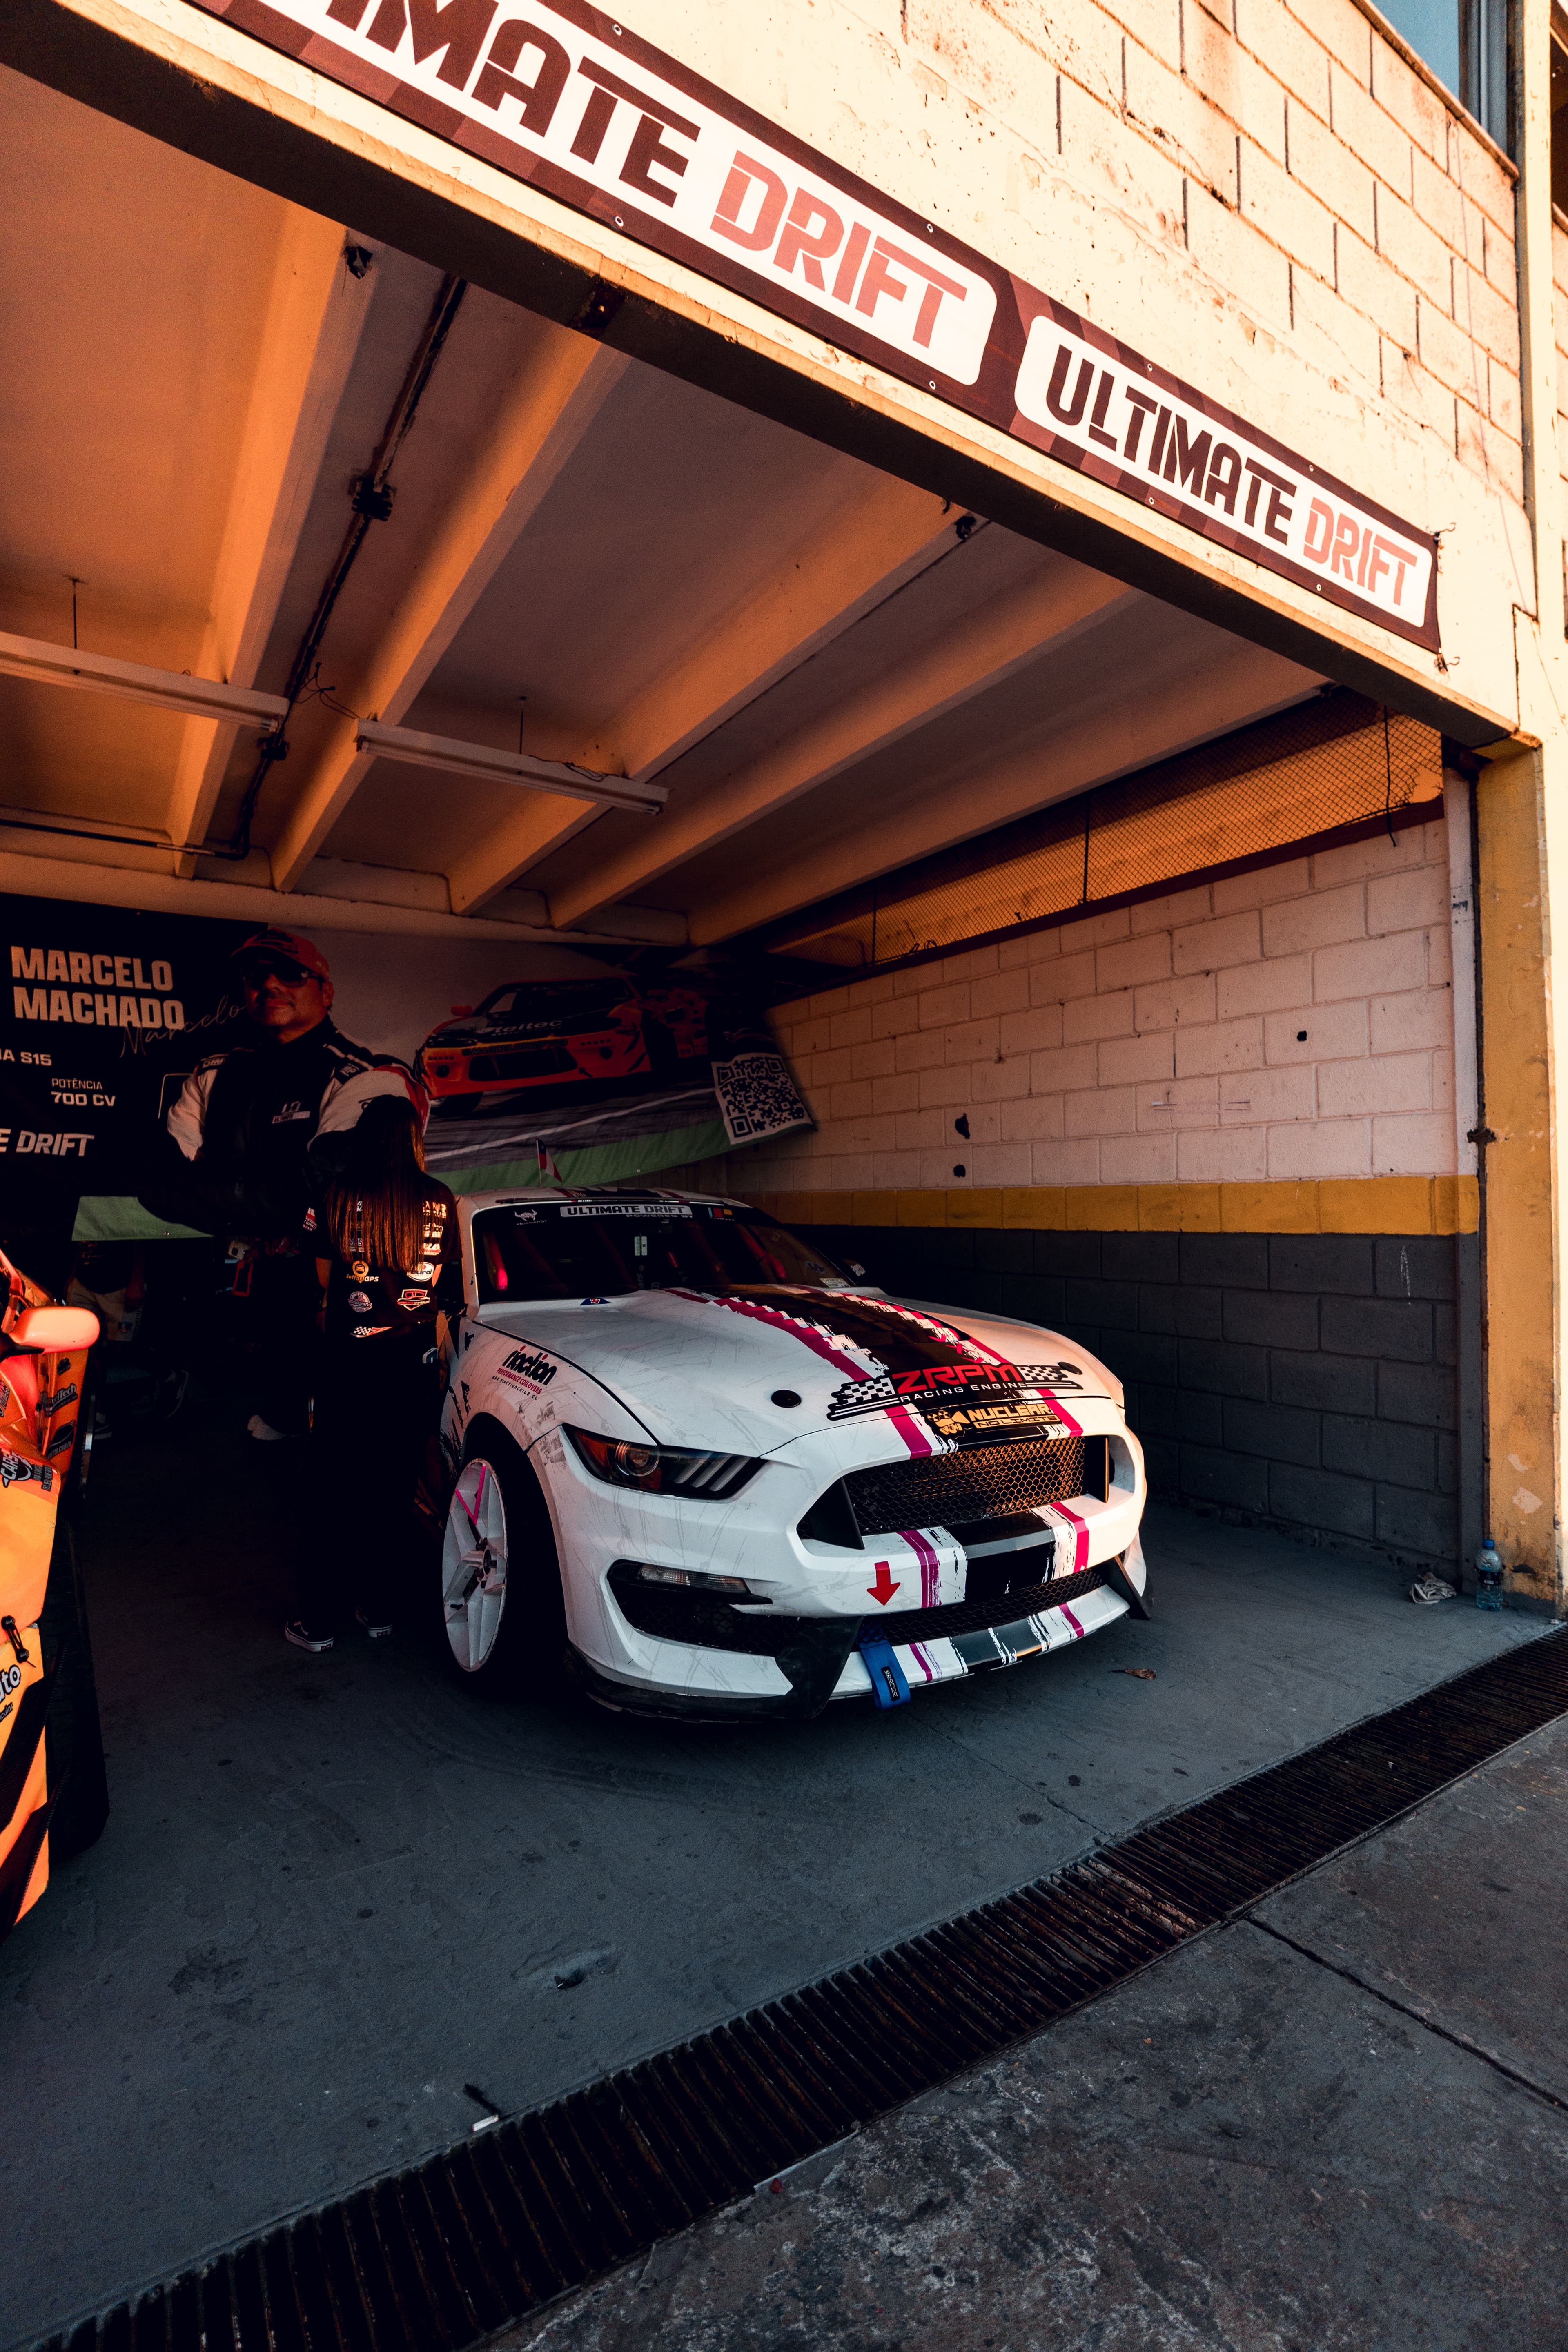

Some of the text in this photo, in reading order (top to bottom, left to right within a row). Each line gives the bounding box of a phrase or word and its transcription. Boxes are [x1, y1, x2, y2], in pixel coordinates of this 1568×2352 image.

[710, 150, 967, 349] DRIFT
[1046, 344, 1417, 606] ULTIMATE DRIFT
[10, 945, 174, 992] MARCELO
[13, 986, 185, 1031] MACHADO
[20, 1051, 53, 1067] S15
[51, 1078, 103, 1091] POTÊNCIA
[50, 1091, 116, 1107] 700 CV
[16, 1129, 96, 1158] DRIFT
[567, 1205, 685, 1215] ULTIMATE DRIFT
[496, 1368, 543, 1394] PERFORMANCE COILOVERS
[891, 1364, 1023, 1394] ZRPM
[900, 1382, 1027, 1403] RACING ENGINE
[967, 1403, 1052, 1421] NUCLEAR
[1001, 1416, 1058, 1424] LIMITS
[884, 1670, 898, 1697] sparco
